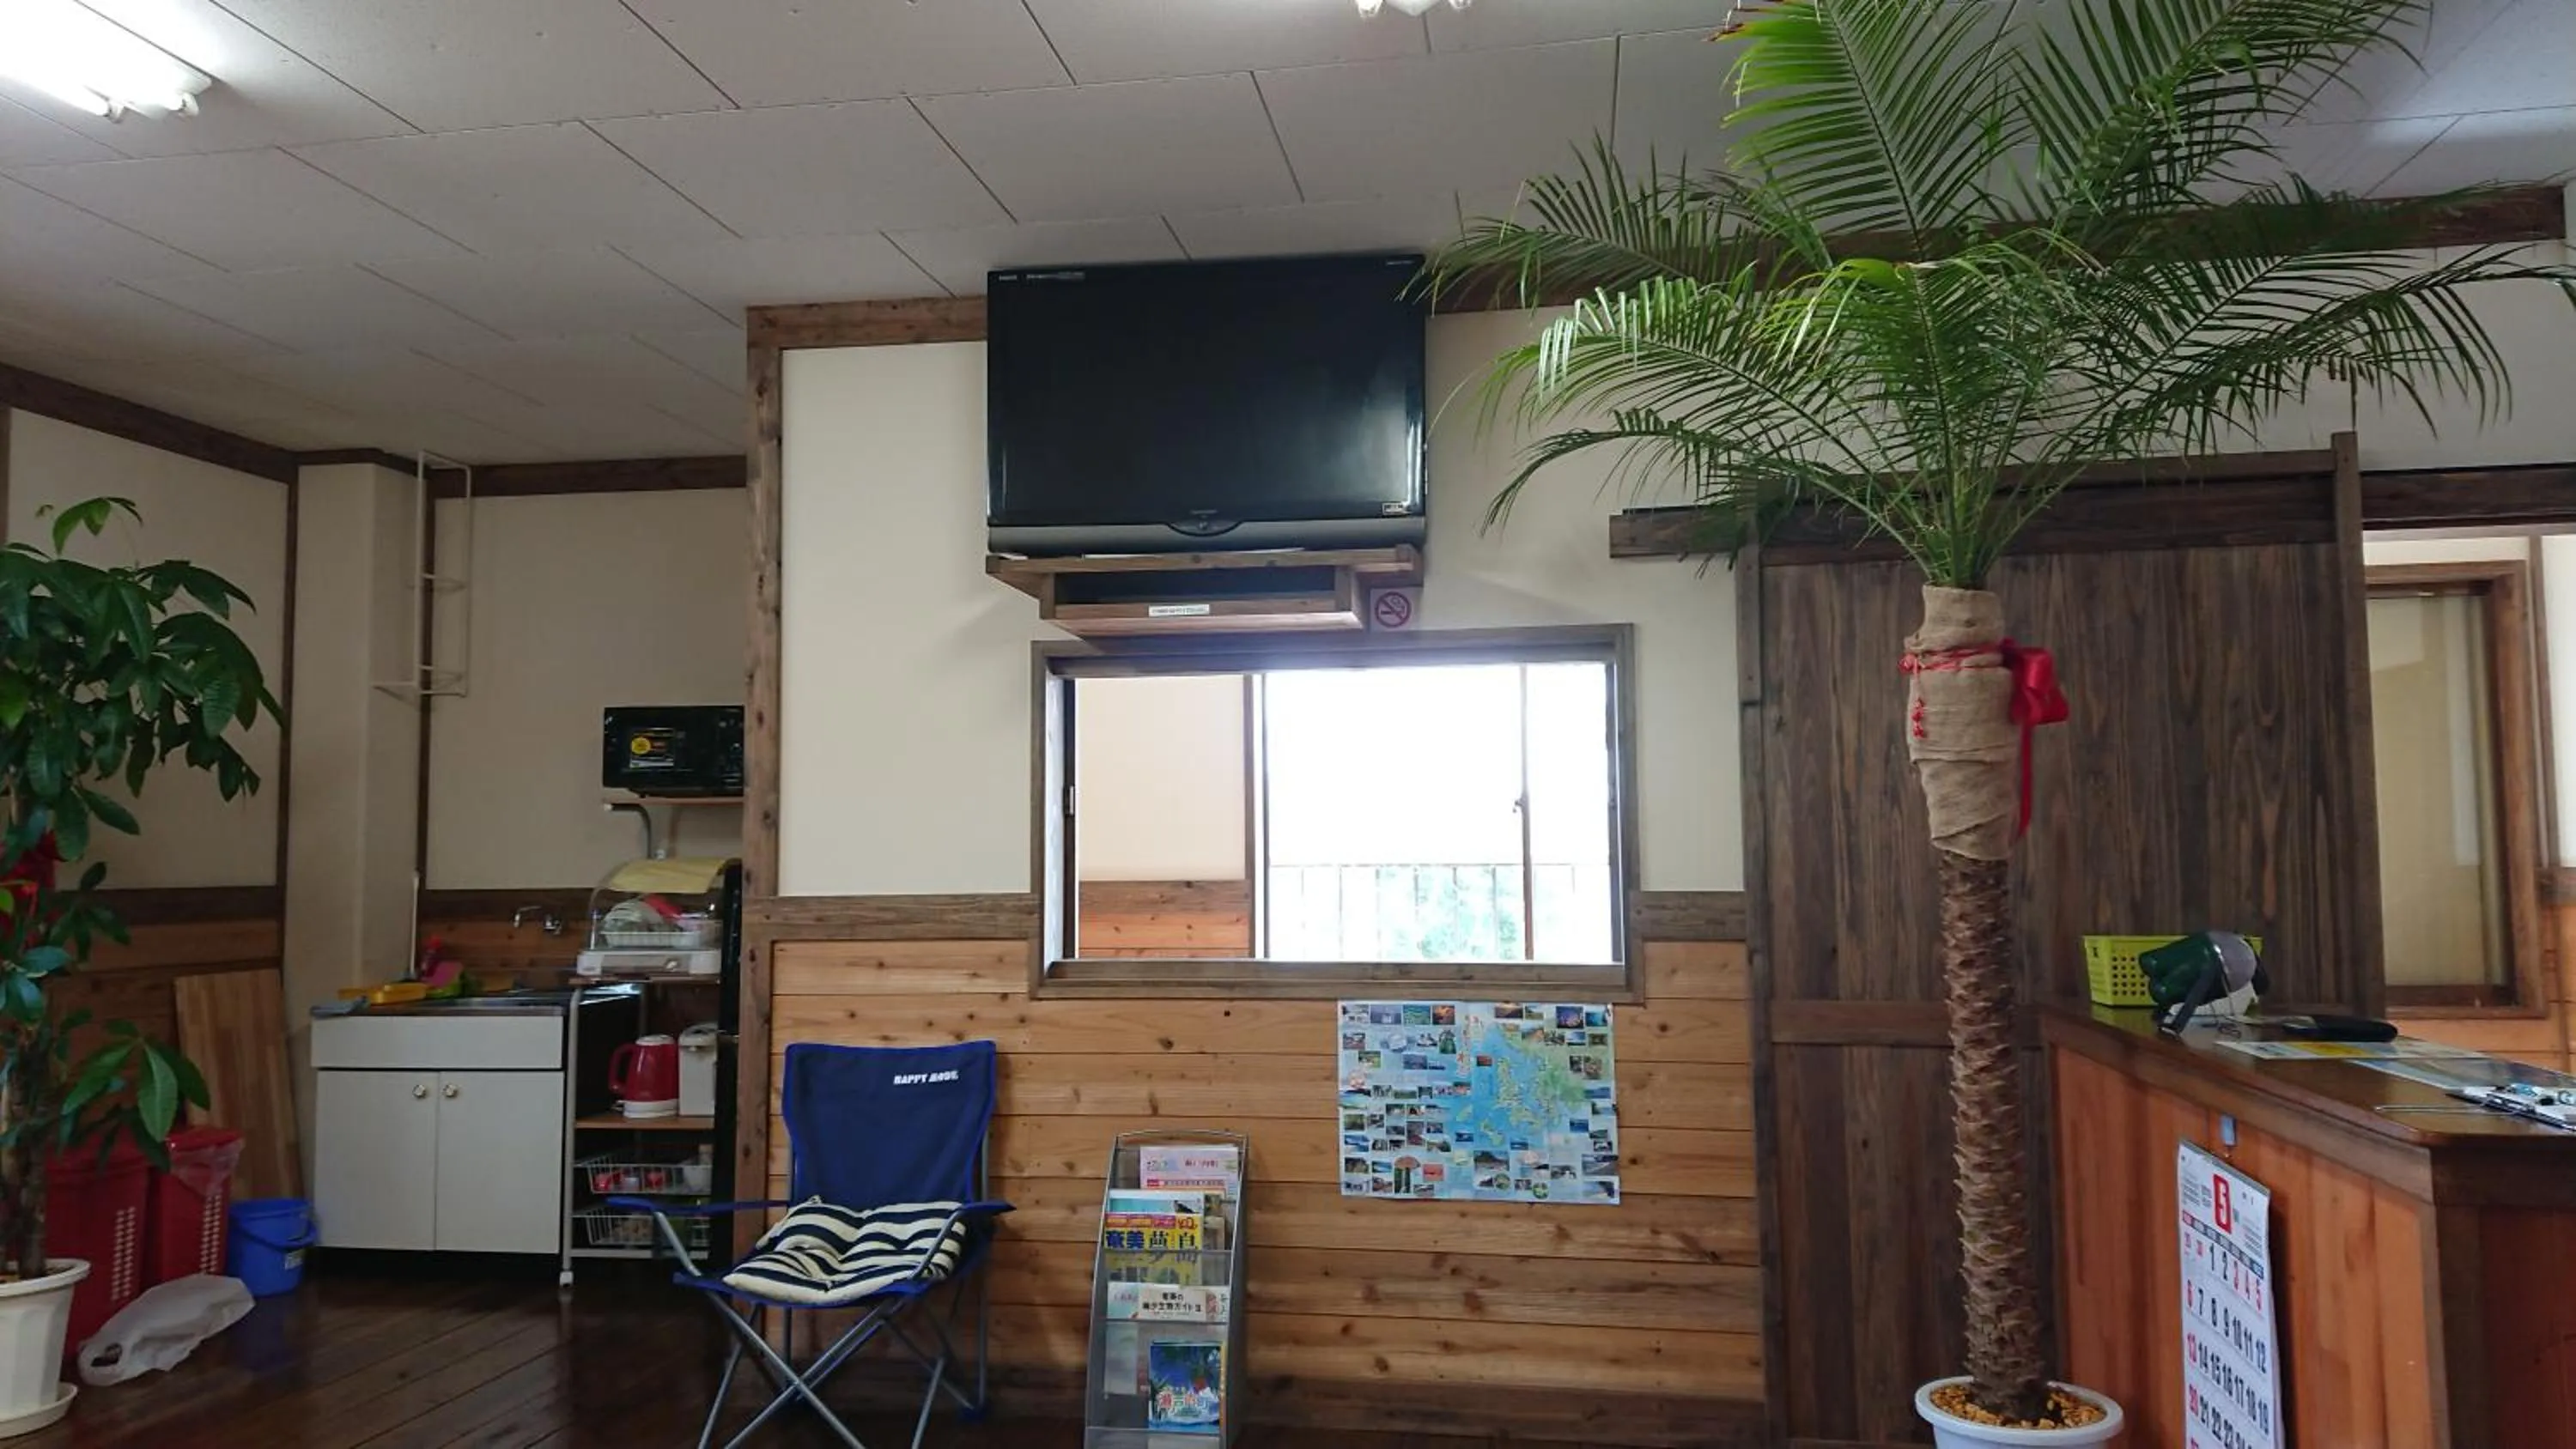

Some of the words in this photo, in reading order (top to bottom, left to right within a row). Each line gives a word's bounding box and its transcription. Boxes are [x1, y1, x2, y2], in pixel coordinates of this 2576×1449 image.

[2222, 1251, 2228, 1281] 2
[2198, 1288, 2204, 1316] 7
[2211, 1297, 2217, 1327] 8
[2224, 1307, 2230, 1337] 9
[2233, 1316, 2242, 1349] 10
[2244, 1327, 2253, 1362] 11
[2256, 1339, 2266, 1373] 12
[2198, 1342, 2208, 1373] 14
[2211, 1352, 2221, 1385] 15
[2222, 1362, 2233, 1397] 16
[2234, 1374, 2244, 1409] 17
[2246, 1386, 2257, 1422] 18
[2257, 1398, 2269, 1435] 19
[2200, 1395, 2209, 1428] 21
[2212, 1406, 2221, 1440] 22
